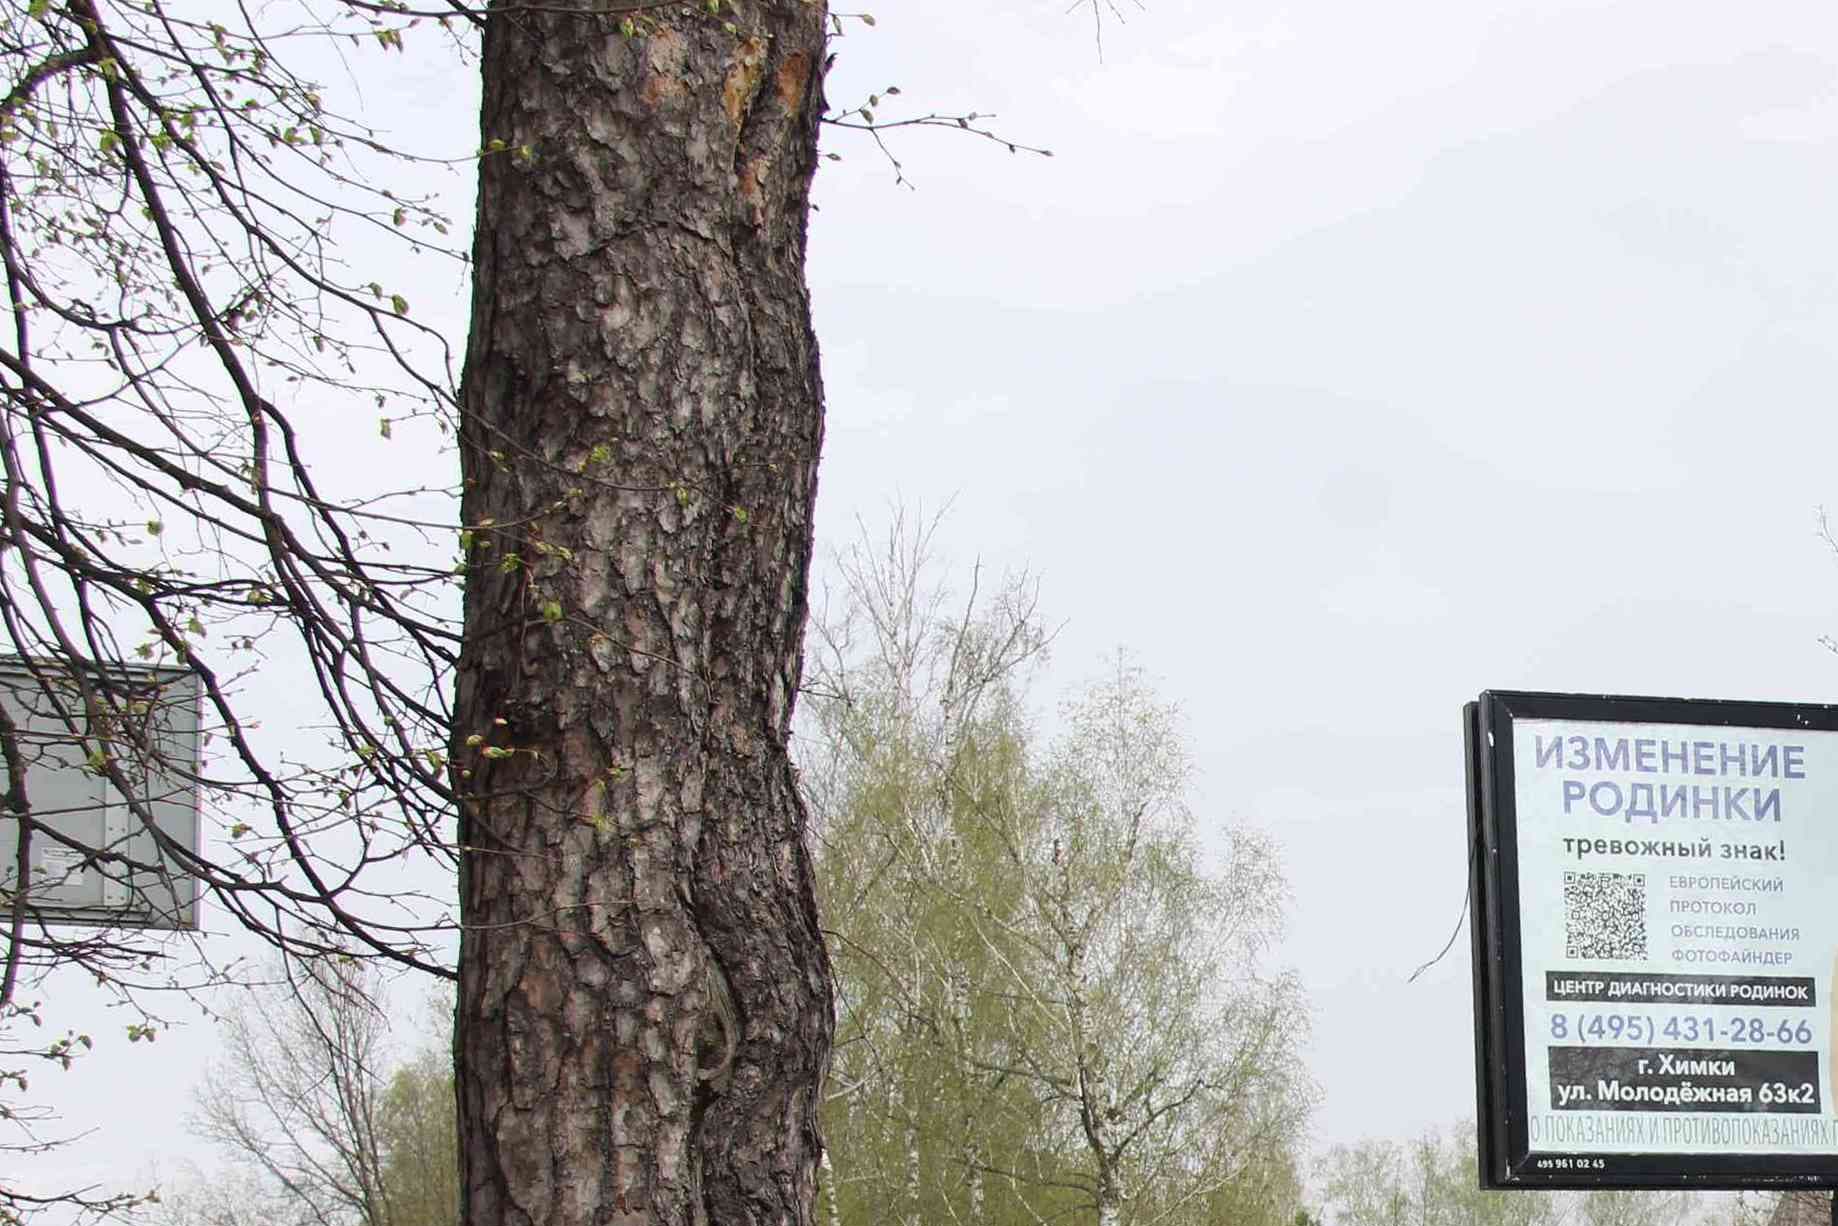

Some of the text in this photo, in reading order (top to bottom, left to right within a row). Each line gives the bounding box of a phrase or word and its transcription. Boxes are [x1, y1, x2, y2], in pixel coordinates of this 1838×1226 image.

[1535, 735, 1806, 779] ИЗМЕНЕНИЕ
[1563, 780, 1781, 824] РОДИНКИ
[1563, 837, 1786, 861] тревожный знак!
[1669, 876, 1784, 892] ЕВРОПЕЙСКИЙ
[1669, 900, 1756, 915] ПРОТОКОЛ
[1671, 925, 1800, 941] ОБСЛЕДОВАНИЯ
[1672, 949, 1793, 965] ФОТОФАЙНДЕР
[1554, 980, 1808, 1000] ЦЕНТР ДИАГНОСТИКИ РОДИНОК
[1551, 1014, 1812, 1043] 8 (495) 431-28-66
[1638, 1054, 1735, 1075] г. Химки
[1557, 1080, 1815, 1106] ул. Молодёжная 63к2
[1530, 1115, 1540, 1142] О
[1546, 1115, 1645, 1144] ПОКАЗАНИЯХ
[1650, 1117, 1657, 1144] И
[1663, 1117, 1829, 1146] ПРОТИВОПОКАЗАНИЯХ
